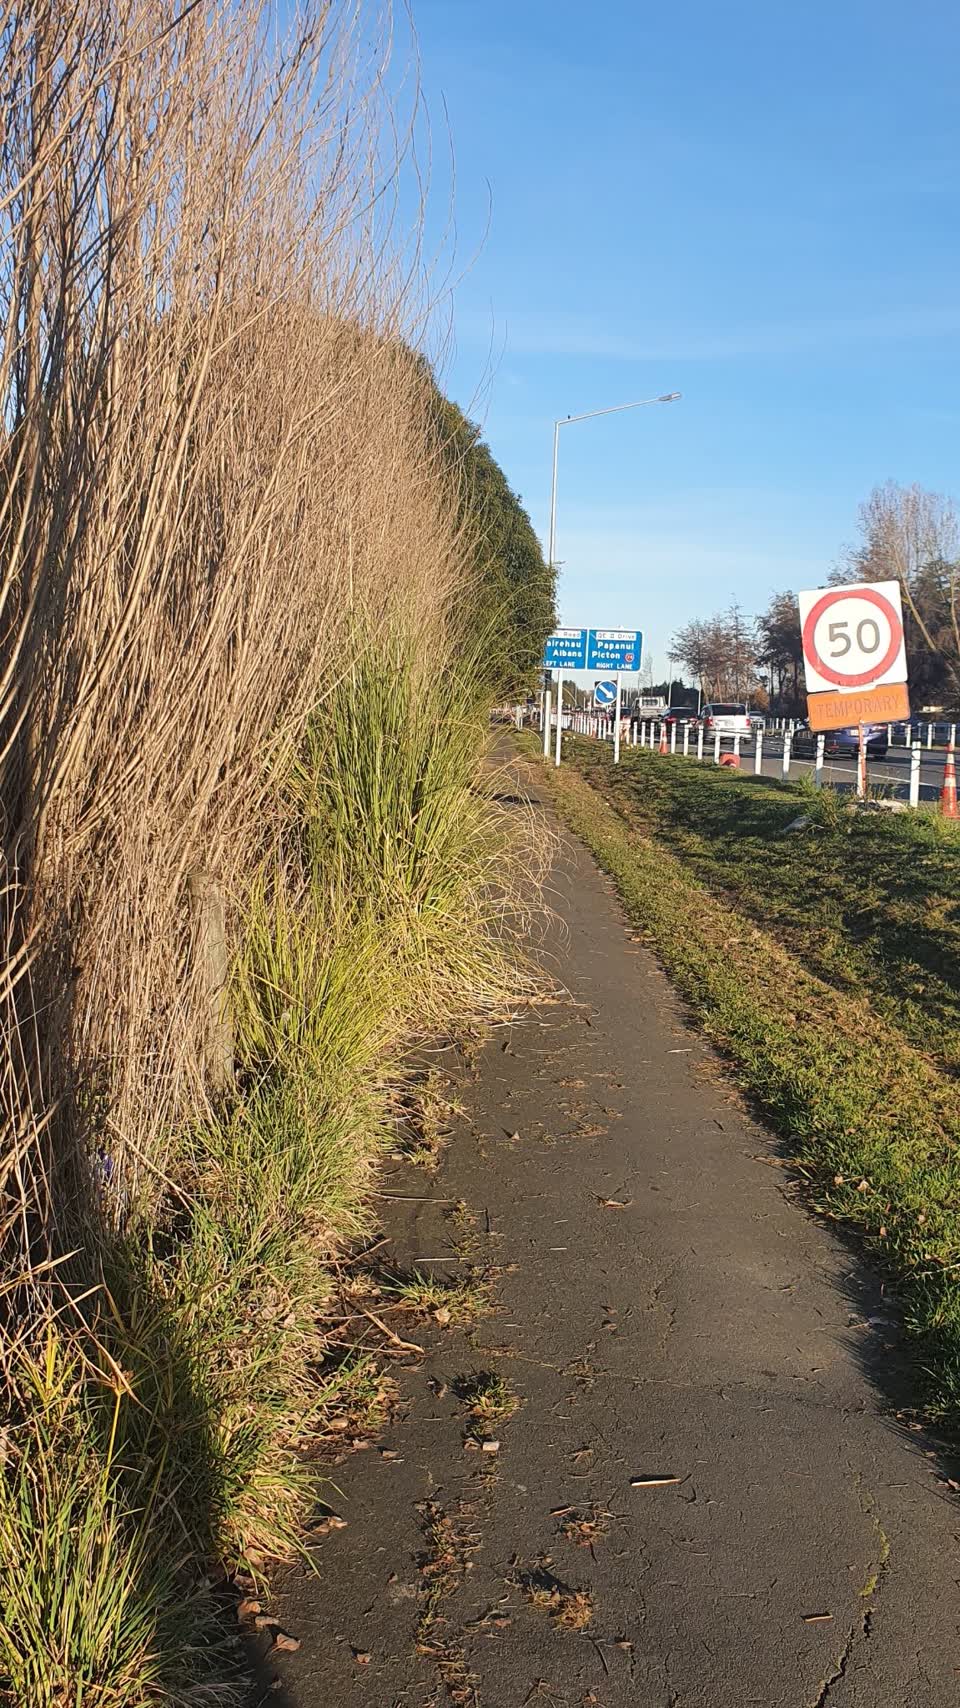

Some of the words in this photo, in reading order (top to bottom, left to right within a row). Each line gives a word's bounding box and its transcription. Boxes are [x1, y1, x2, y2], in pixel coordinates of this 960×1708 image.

[828, 618, 880, 658] 50
[546, 639, 581, 648] airehau
[597, 641, 635, 651] Papanui
[552, 649, 582, 657] Albans
[591, 650, 620, 659] Picton
[815, 695, 900, 719] TEMPORARY
